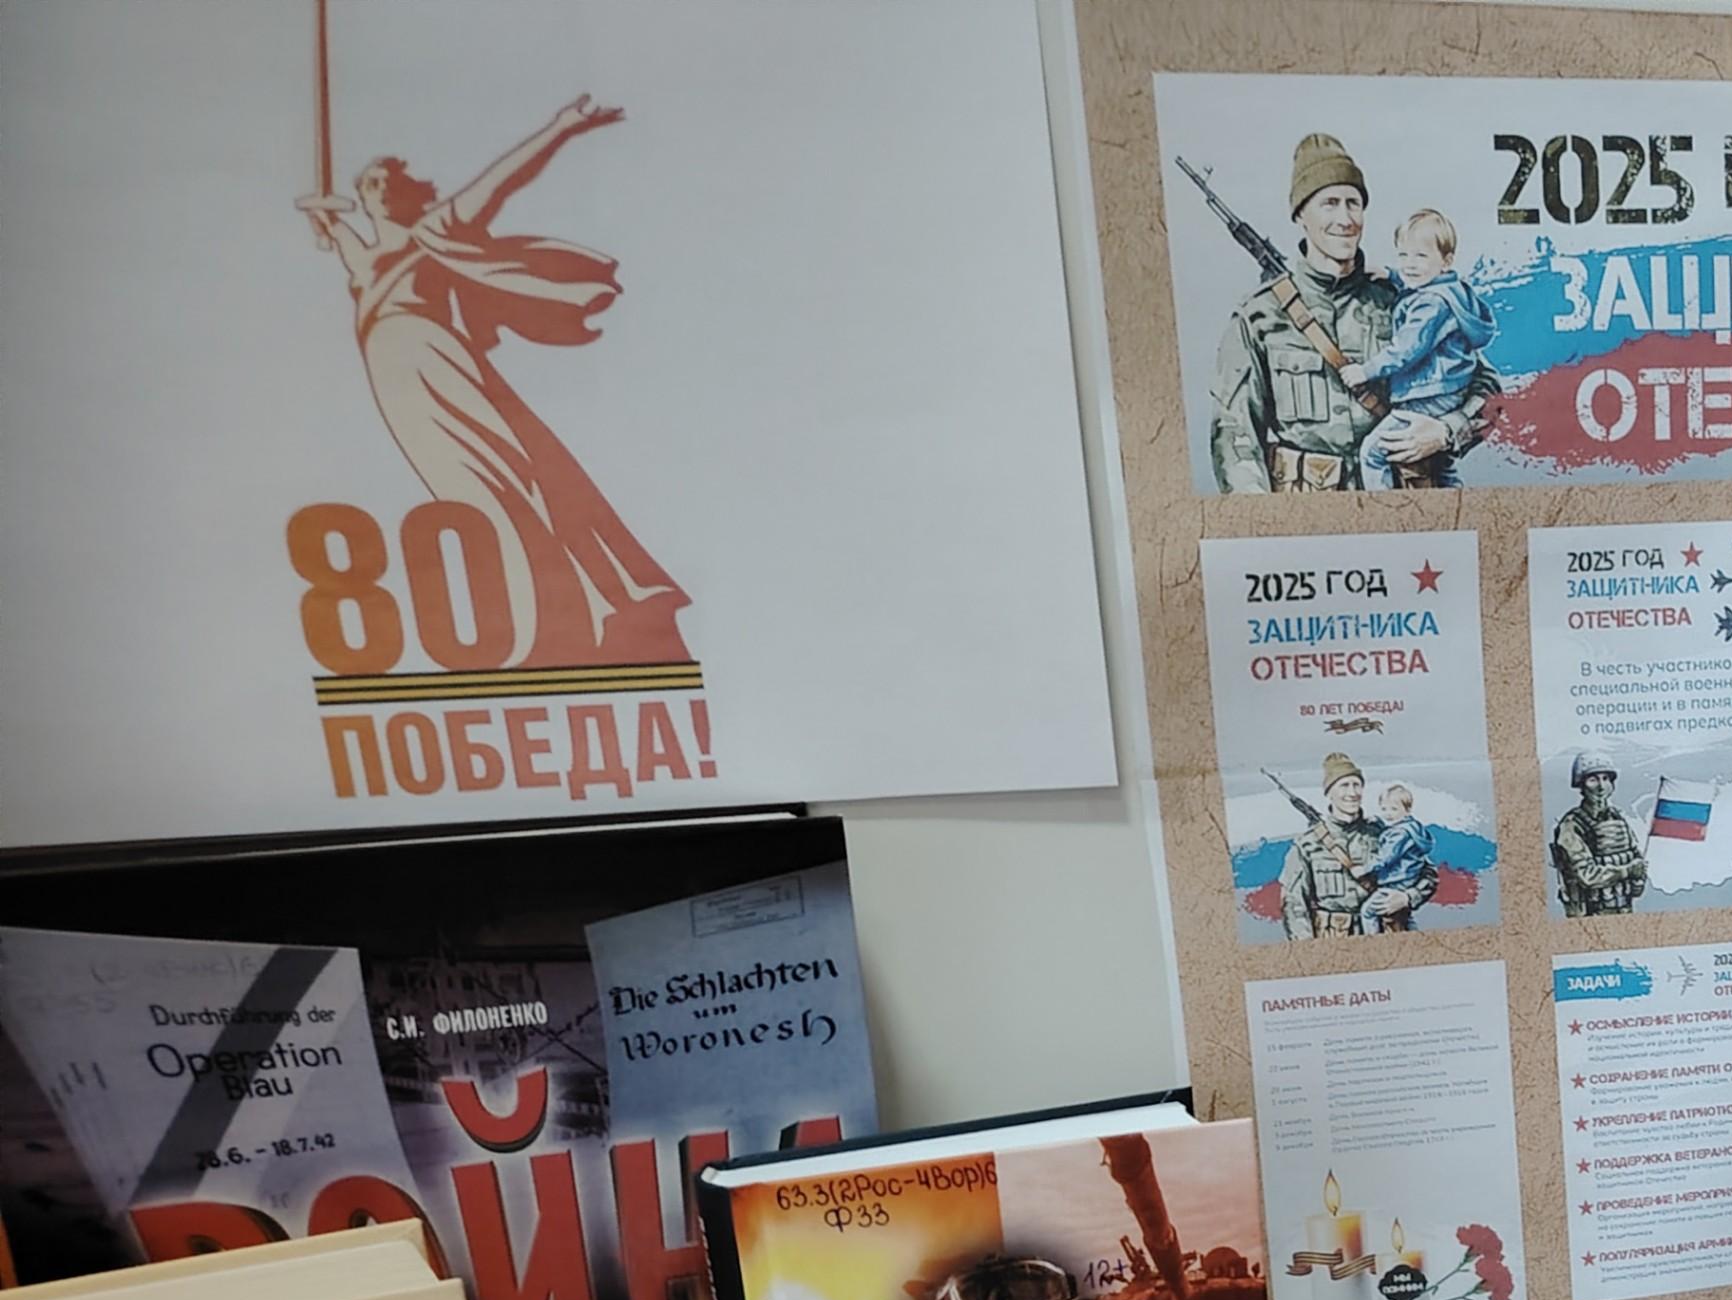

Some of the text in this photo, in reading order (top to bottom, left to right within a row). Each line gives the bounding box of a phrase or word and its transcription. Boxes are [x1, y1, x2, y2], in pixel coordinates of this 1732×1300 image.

[1491, 134, 1695, 226] 2025
[1567, 549, 1664, 573] 2025 ГОД
[285, 499, 516, 675] 80
[1245, 569, 1388, 603] 2025 ГОД
[1567, 575, 1700, 600] ЗАЩИТНИКА
[1247, 611, 1440, 645] ЗАЩИТНИКА
[1568, 607, 1692, 630] ОТЕЧЕСТВА
[1250, 650, 1429, 682] ОТЕЧЕСТВА
[1580, 662, 1592, 677] В
[1596, 661, 1641, 675] честь
[1570, 680, 1679, 696] специальной
[1576, 702, 1656, 717] операции
[1662, 700, 1672, 710] и
[1677, 699, 1686, 711] в
[1580, 723, 1590, 735] о
[1595, 719, 1672, 735] подвигах
[320, 699, 718, 800] ПОБЕДА!
[610, 956, 840, 1017] Die Schlachten
[1567, 975, 1622, 991] ЗАДАЧИ
[1349, 990, 1391, 1006] ДАТЫ
[149, 1003, 336, 1031] Durchführung der
[385, 1001, 549, 1041] С.И. ФИЛОНЕНКО
[620, 1014, 838, 1063] Woronesh
[146, 1041, 343, 1079] Operation
[222, 1072, 293, 1101] Blau
[1594, 1153, 1672, 1170] ПОДДЕРЖКА
